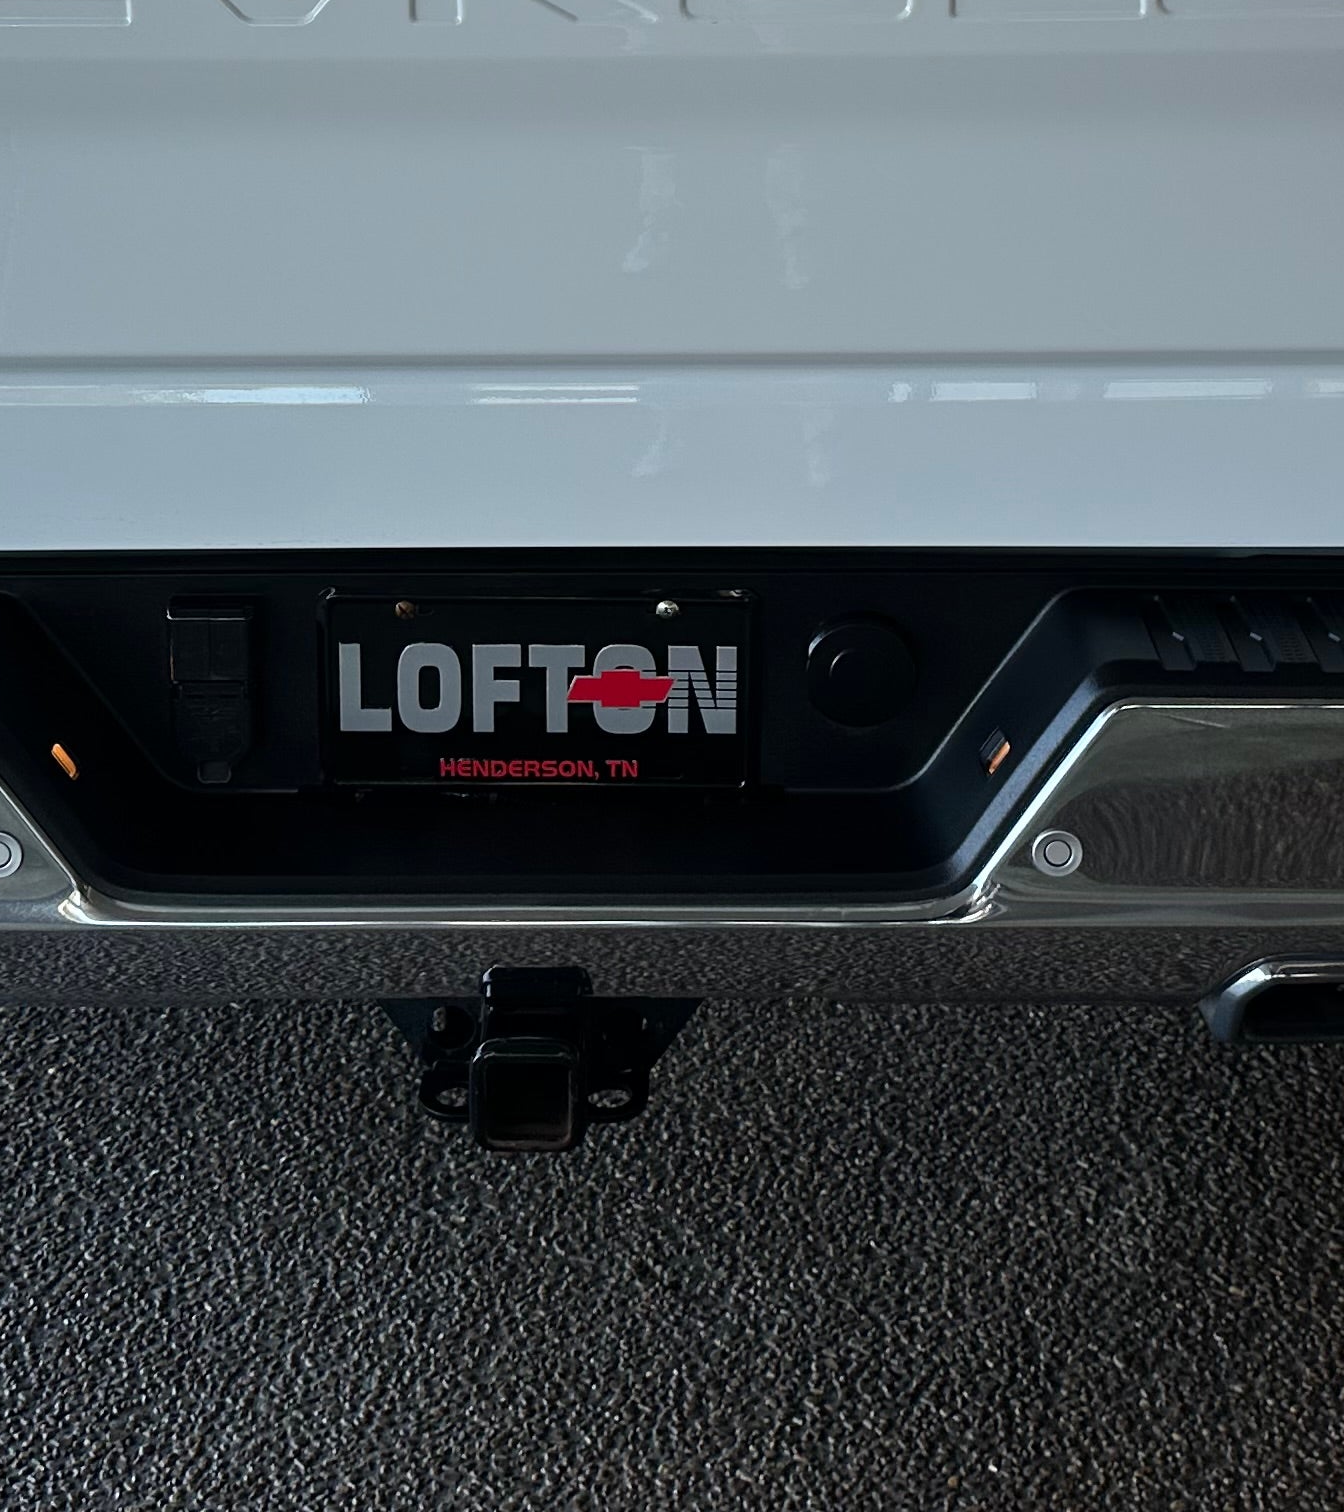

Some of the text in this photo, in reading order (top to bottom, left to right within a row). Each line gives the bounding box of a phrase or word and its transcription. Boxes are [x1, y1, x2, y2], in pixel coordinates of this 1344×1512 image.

[339, 642, 737, 734] LOFTON
[440, 757, 638, 780] HENDERSON, TN
